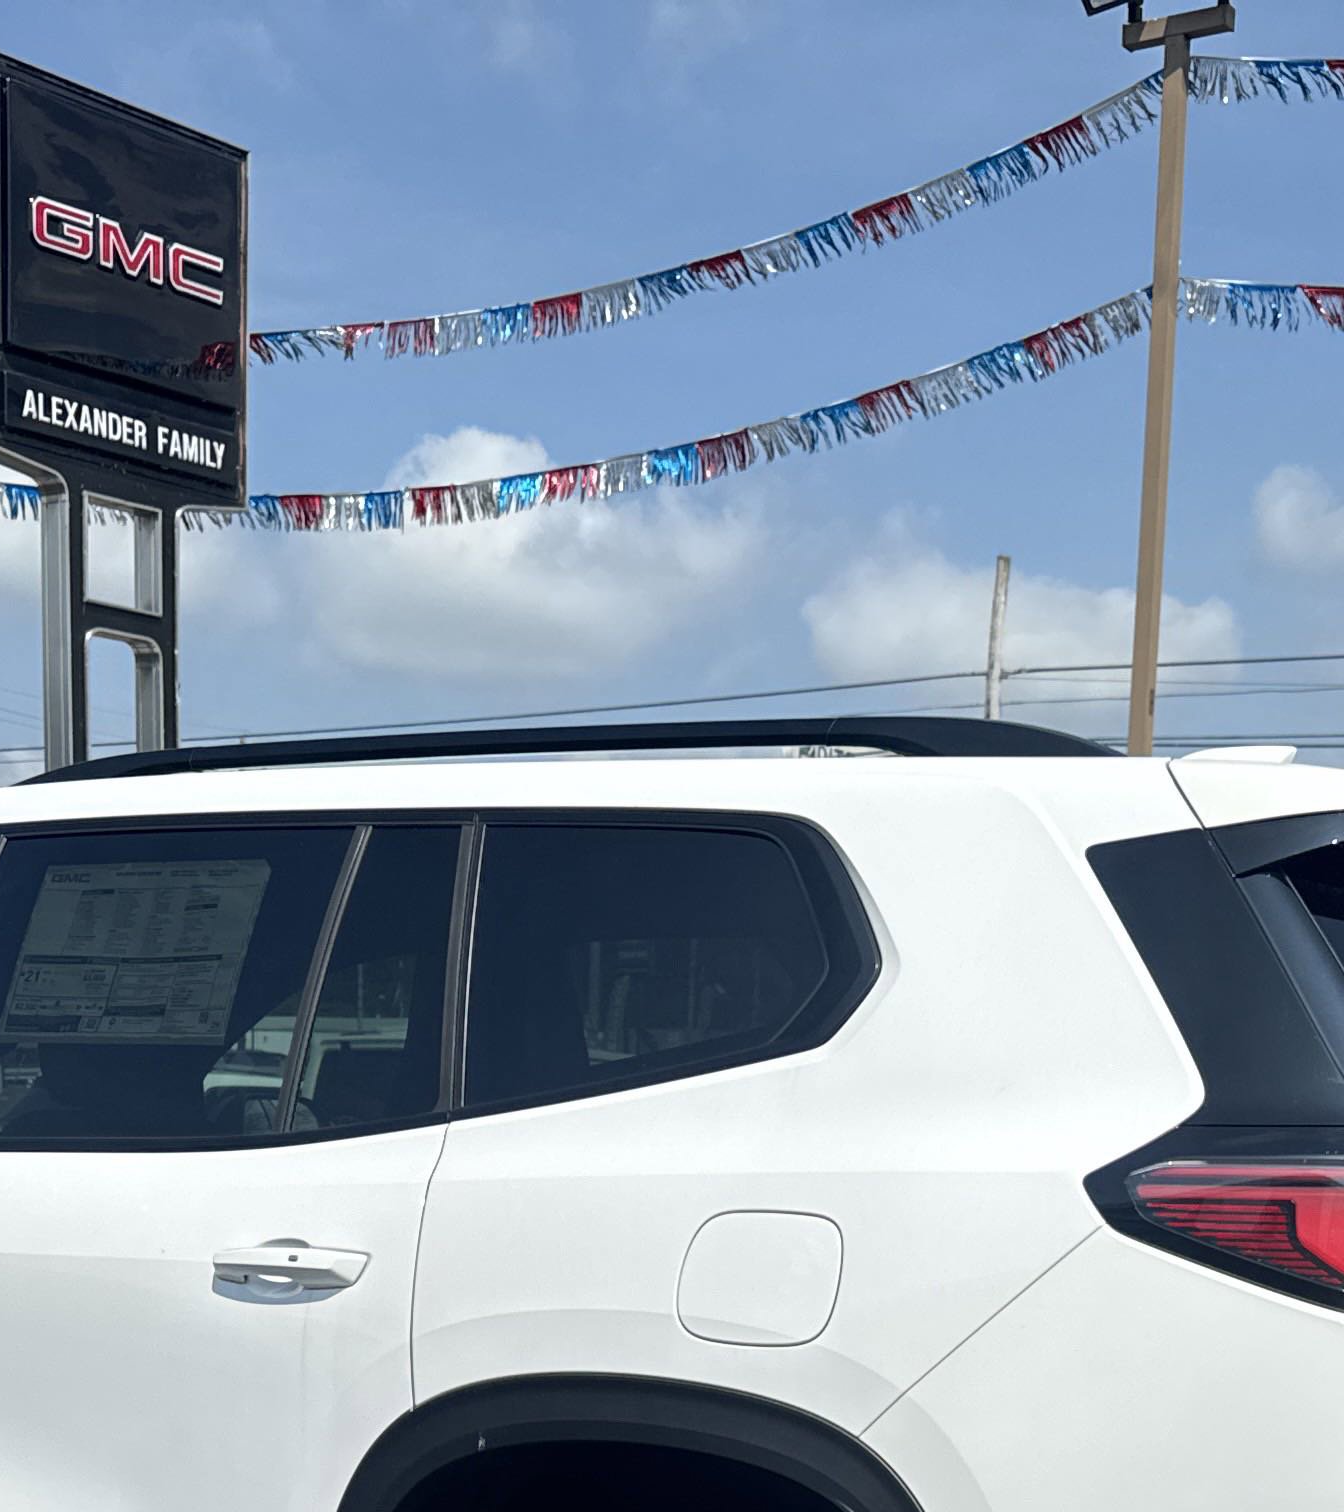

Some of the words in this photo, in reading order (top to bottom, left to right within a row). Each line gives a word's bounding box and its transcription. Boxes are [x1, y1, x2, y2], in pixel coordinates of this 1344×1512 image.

[30, 196, 224, 306] GMC
[22, 388, 148, 449] ALEXANDER
[157, 426, 225, 470] FAMILY
